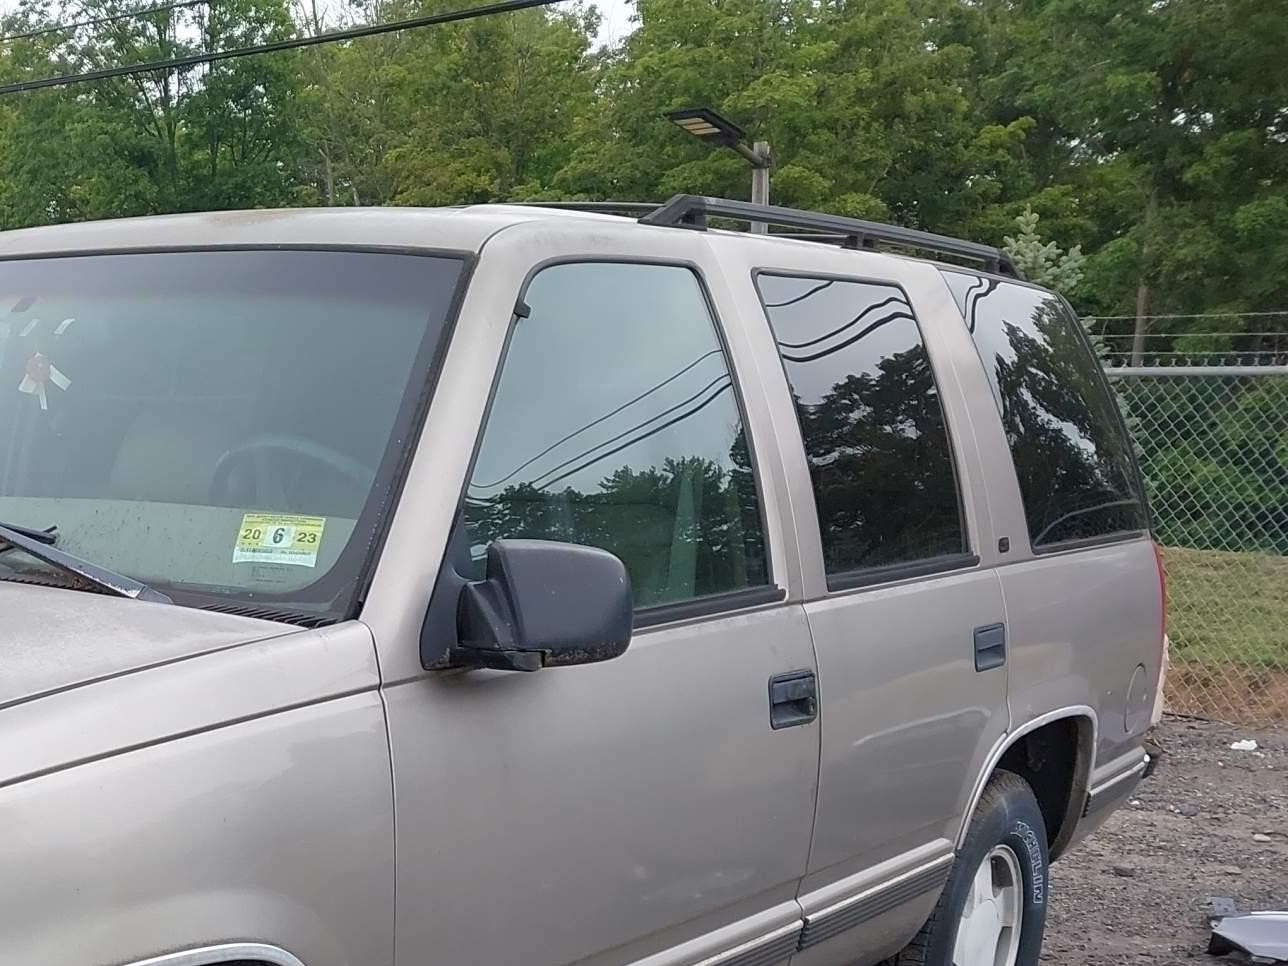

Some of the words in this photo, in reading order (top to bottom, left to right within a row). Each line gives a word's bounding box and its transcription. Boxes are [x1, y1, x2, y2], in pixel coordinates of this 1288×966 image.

[243, 528, 261, 540] 20
[272, 527, 285, 544] 6
[296, 532, 317, 544] 23
